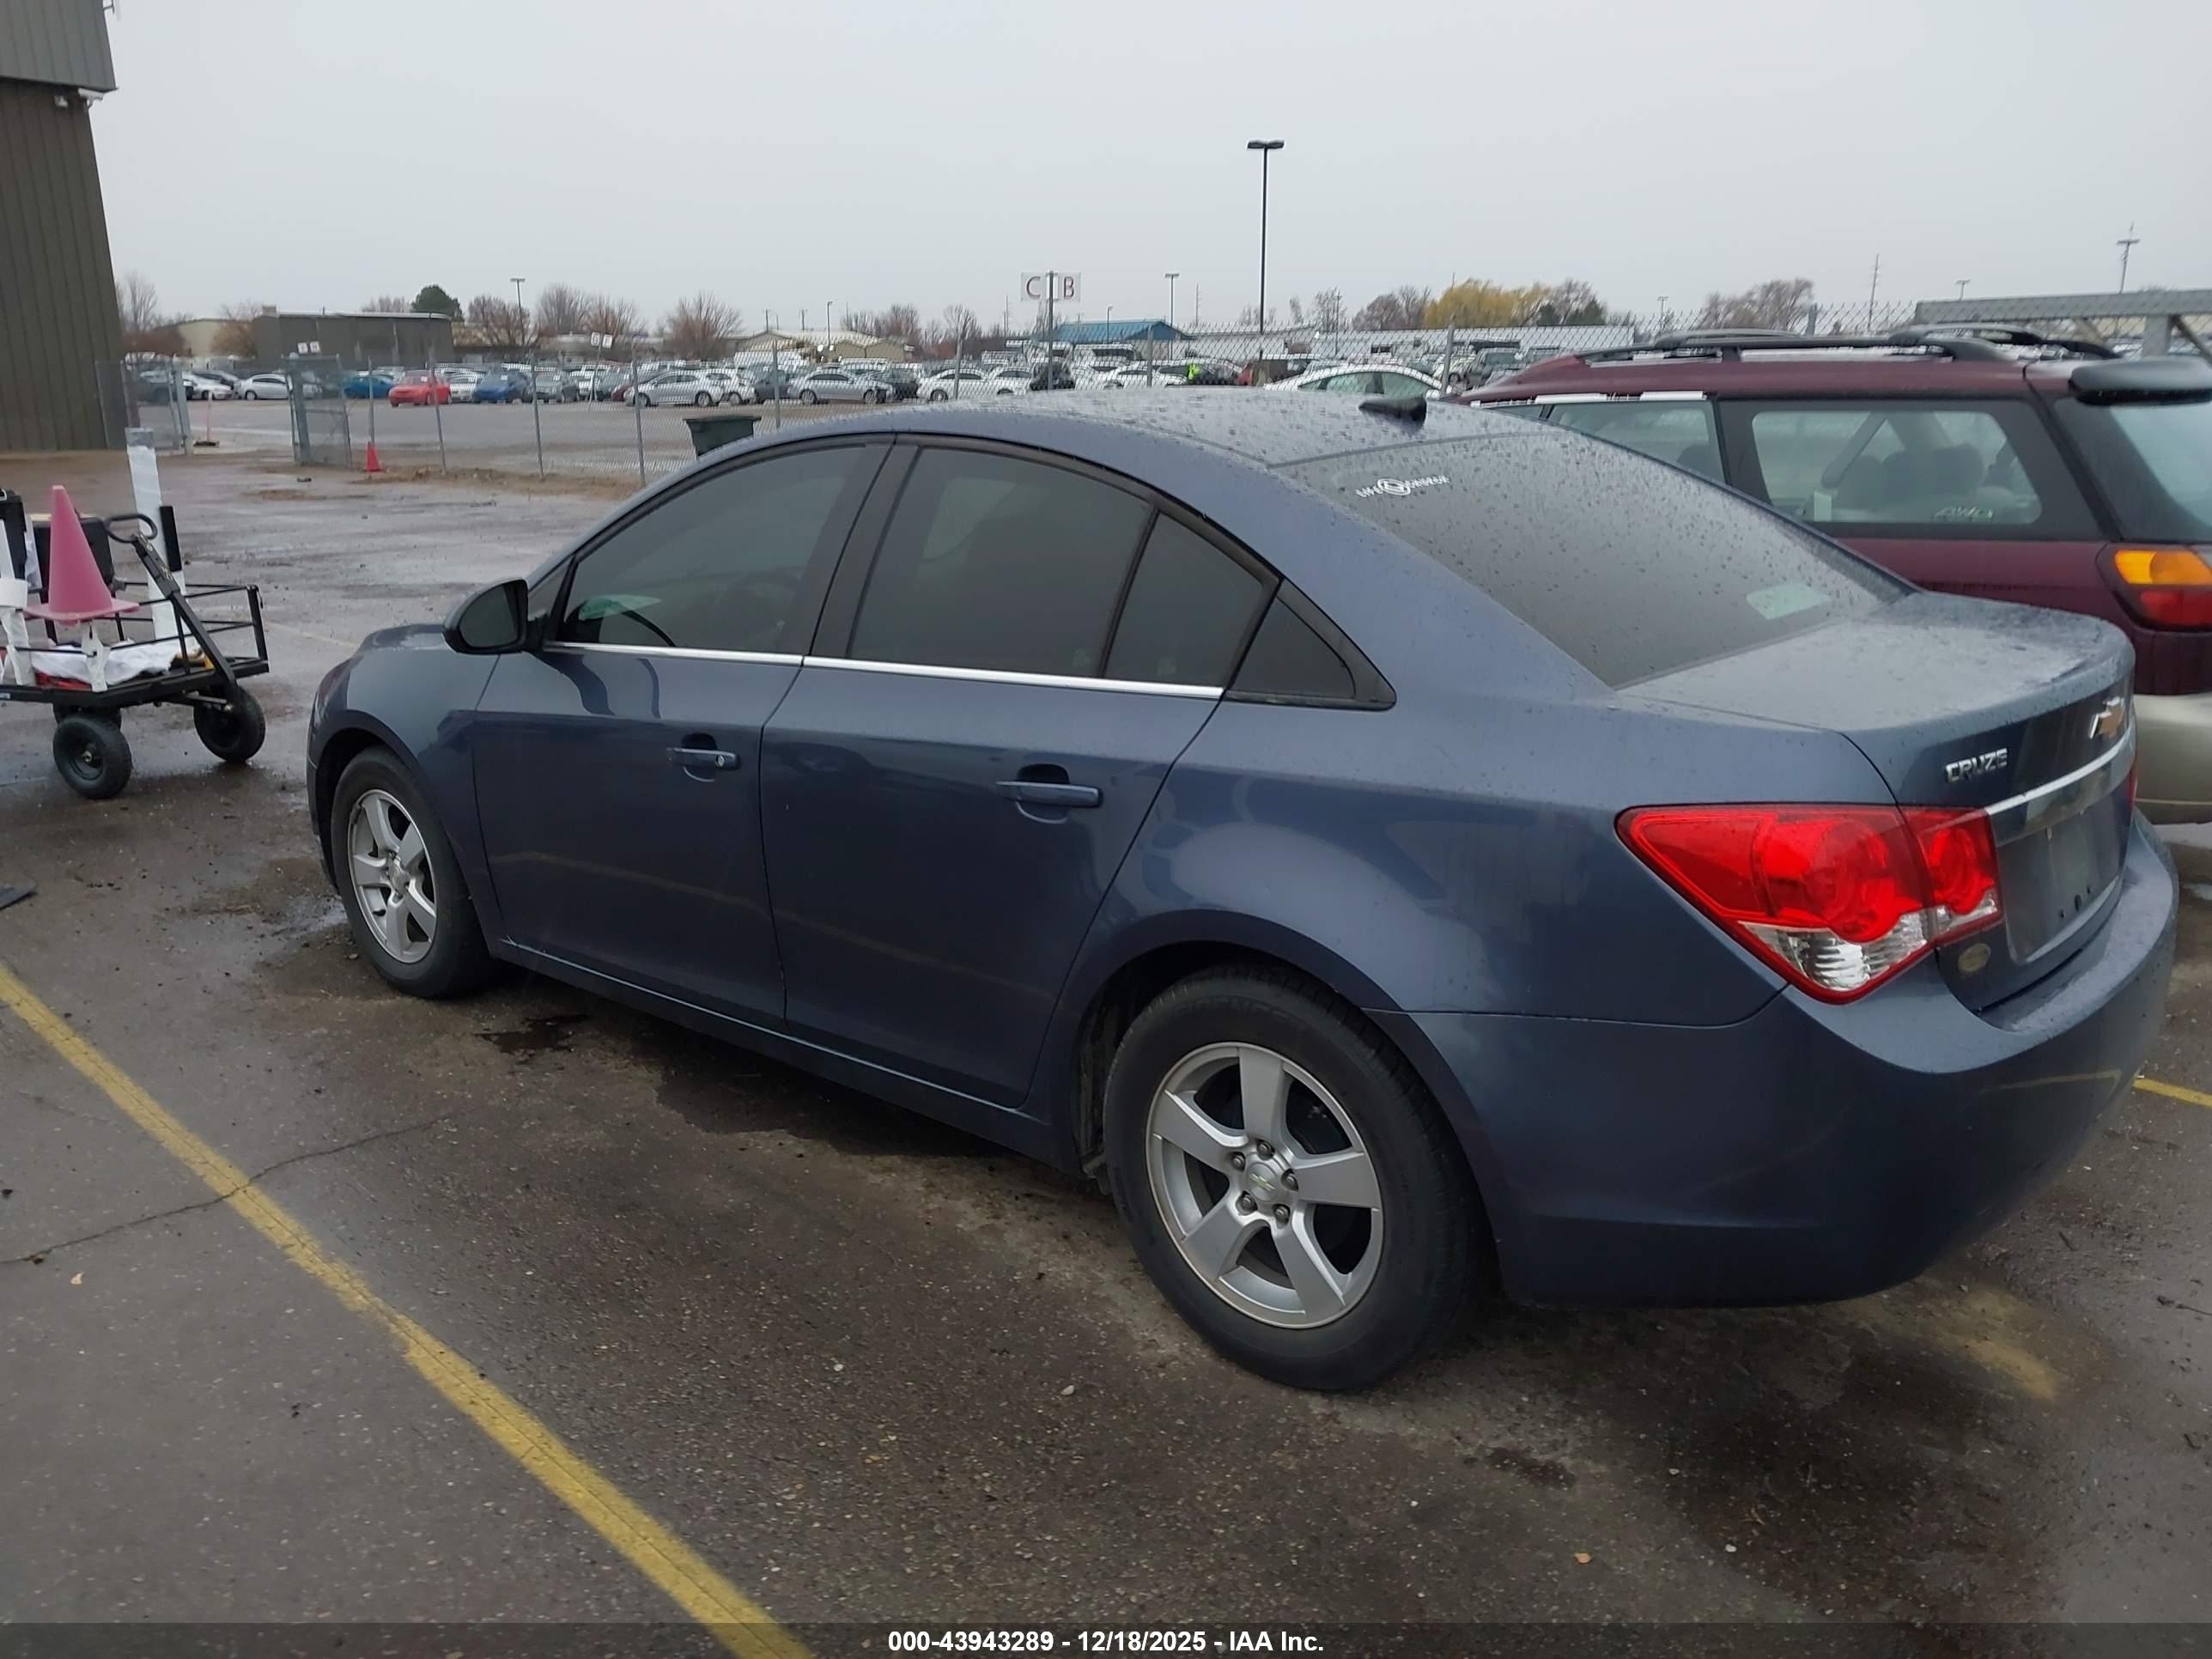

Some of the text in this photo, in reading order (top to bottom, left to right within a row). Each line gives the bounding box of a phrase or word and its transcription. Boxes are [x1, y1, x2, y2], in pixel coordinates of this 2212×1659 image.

[1026, 276, 1041, 300] C
[1063, 276, 1075, 300] B
[1945, 747, 2008, 783] CRUZE
